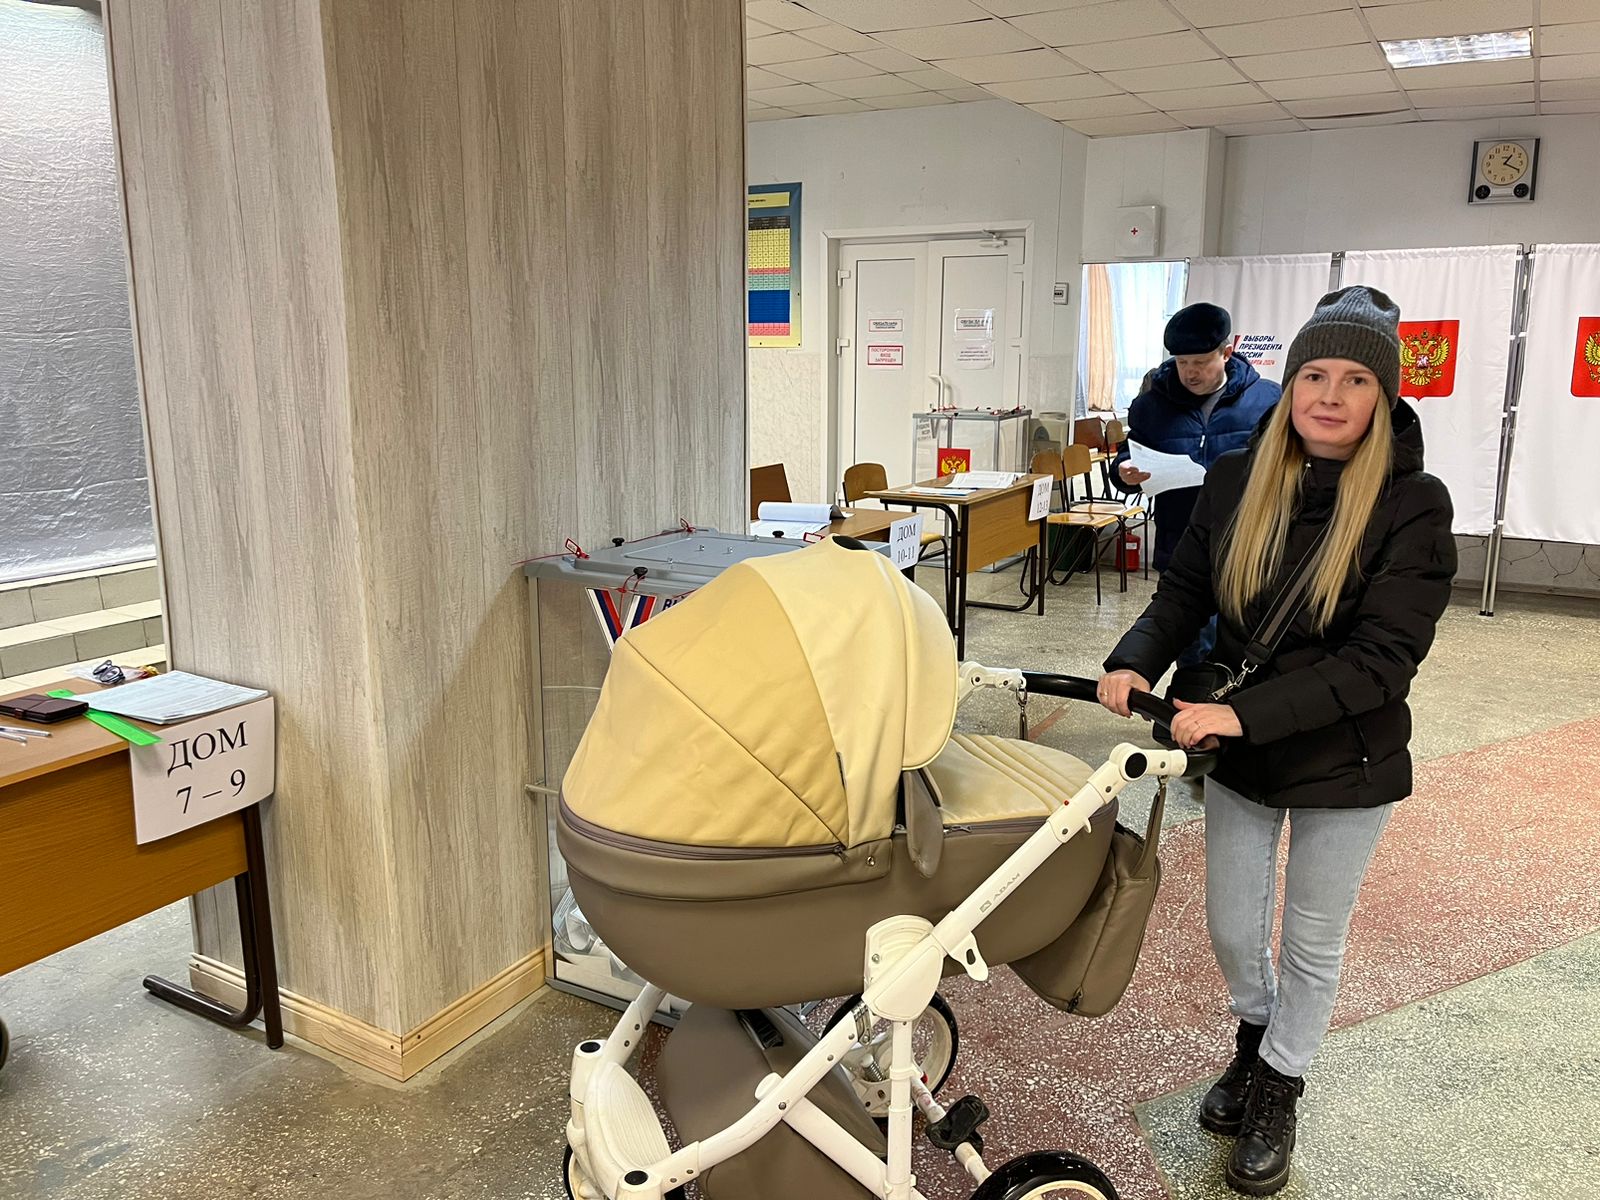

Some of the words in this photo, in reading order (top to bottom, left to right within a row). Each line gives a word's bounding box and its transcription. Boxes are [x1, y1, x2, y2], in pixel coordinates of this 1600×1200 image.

[1037, 482, 1049, 496] ДОМ
[1037, 500, 1048, 513] 12-13
[897, 523, 916, 542] ДОМ
[897, 546, 915, 564] 10-11
[167, 720, 248, 778] ДОМ
[176, 786, 192, 814] 7
[230, 768, 246, 797] 9
[993, 872, 1020, 901] ADAM
